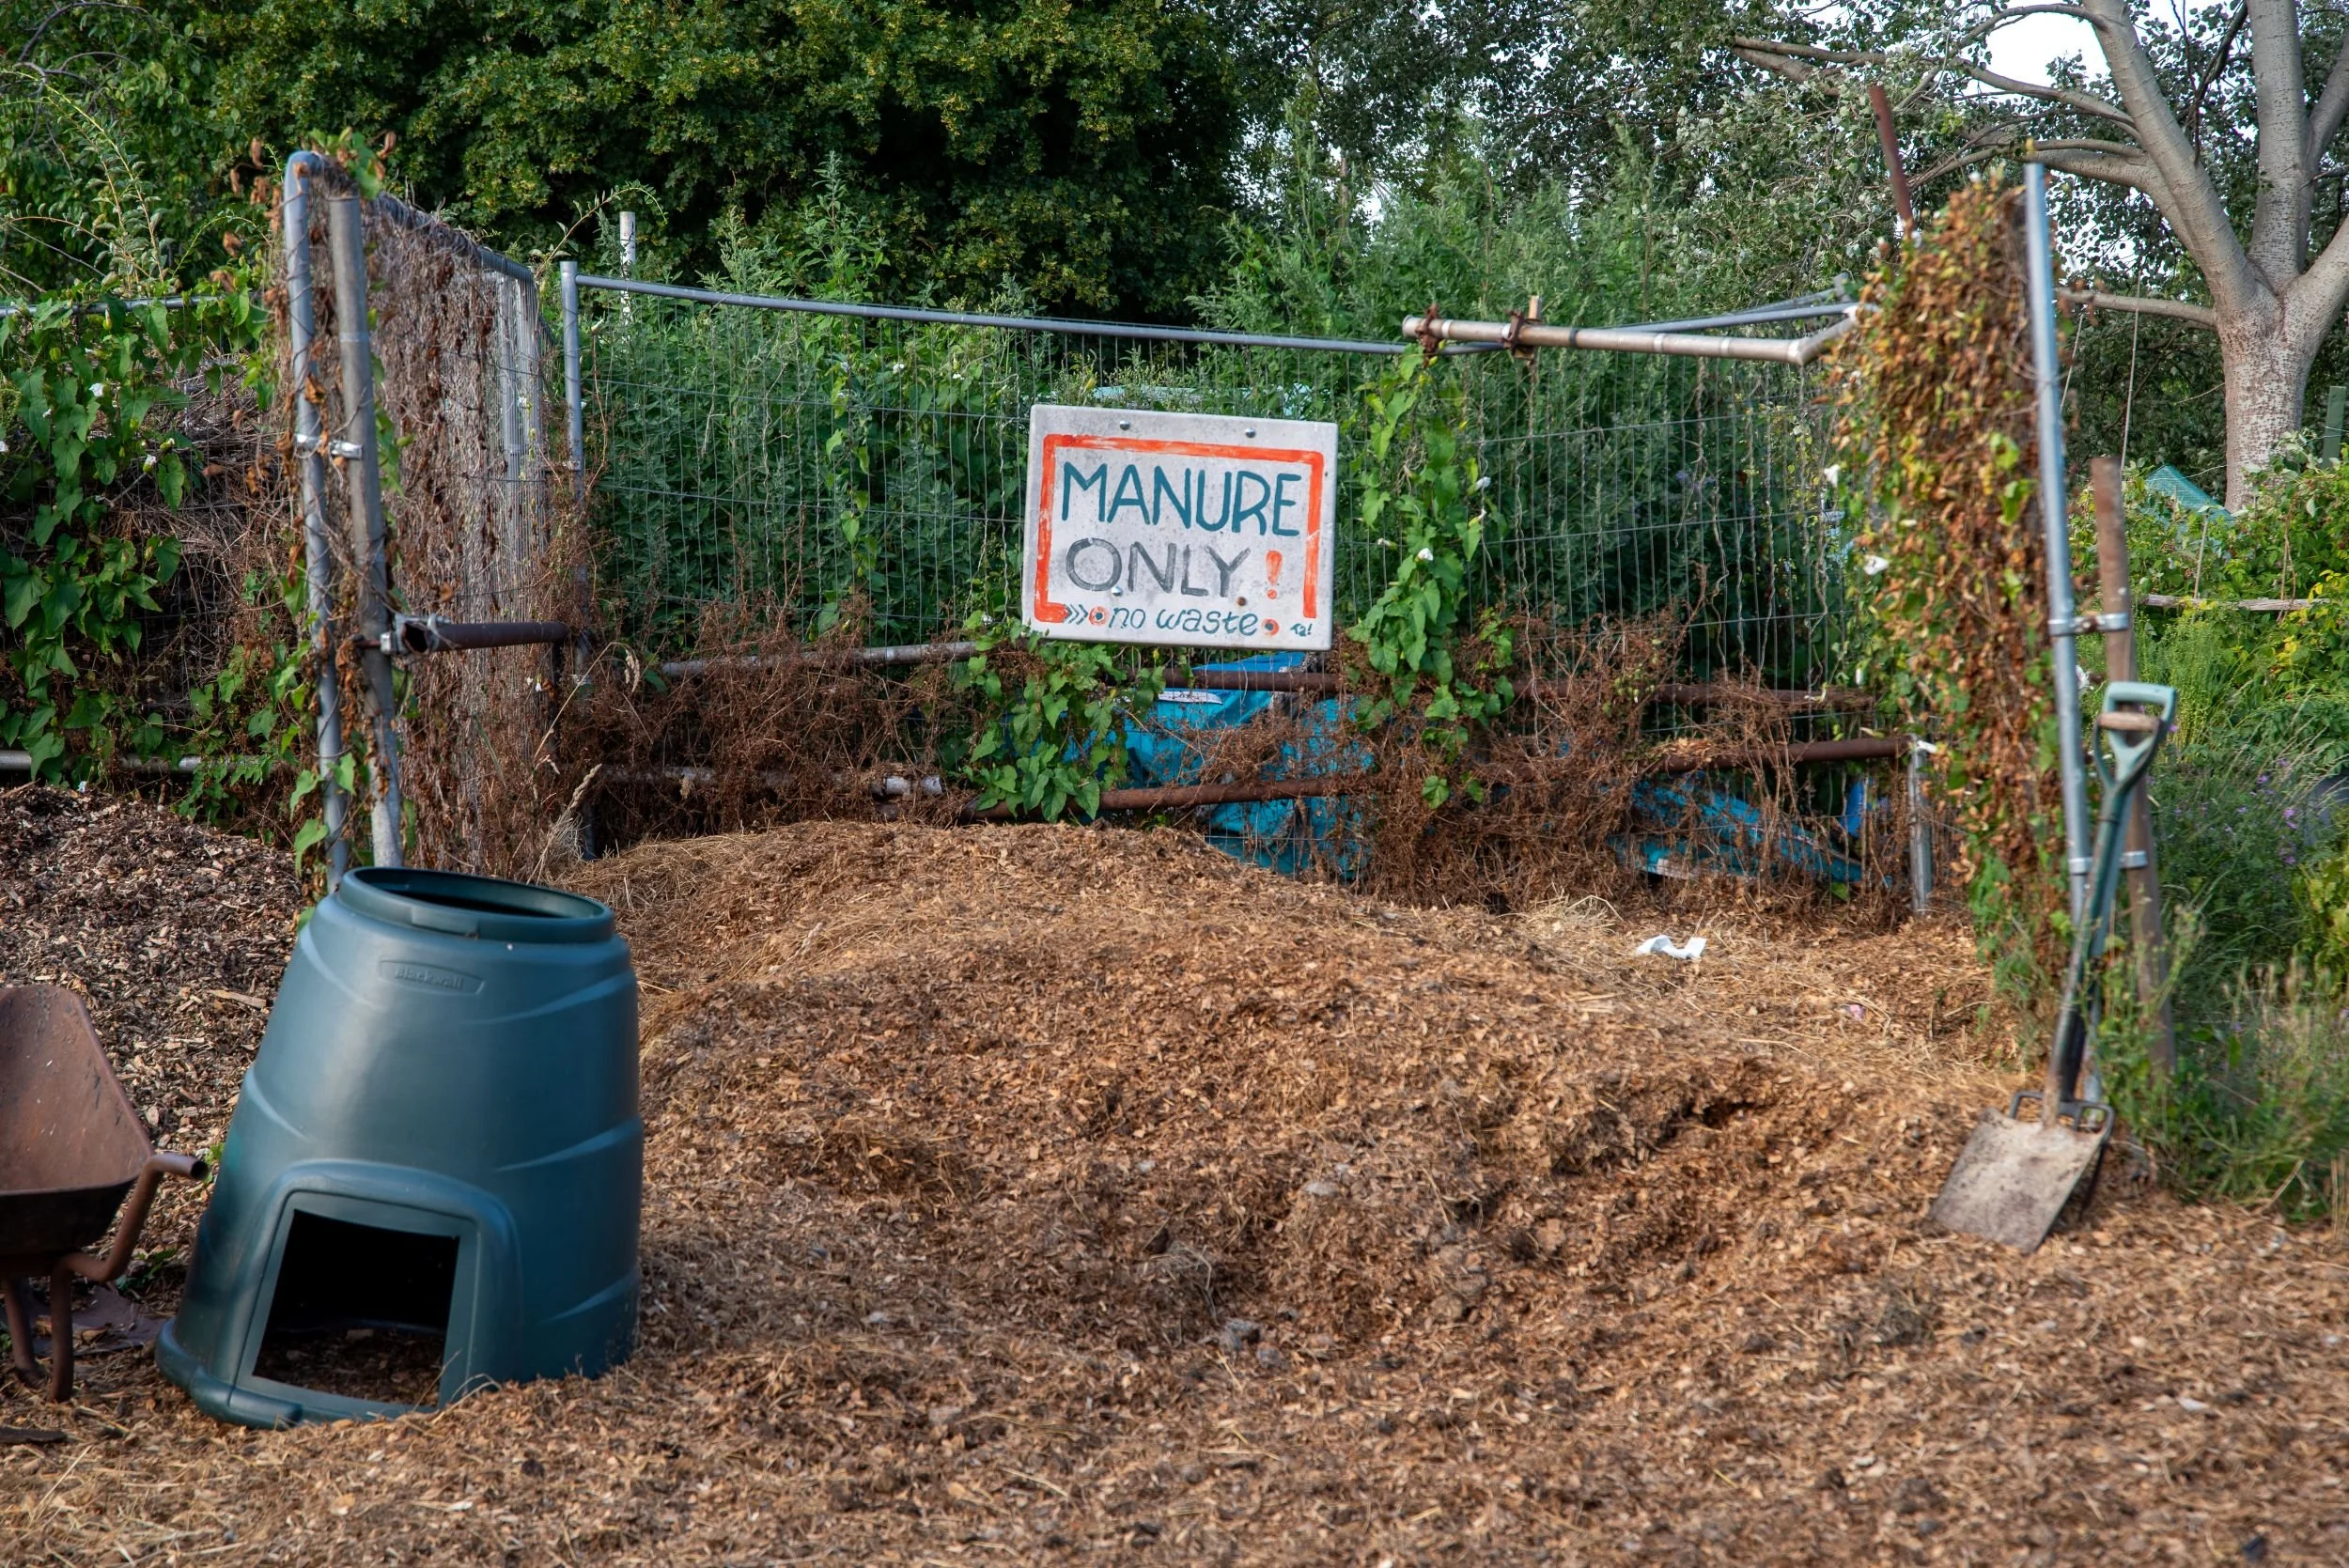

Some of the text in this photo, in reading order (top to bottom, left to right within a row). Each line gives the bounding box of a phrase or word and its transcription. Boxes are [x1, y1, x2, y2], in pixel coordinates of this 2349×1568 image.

[1062, 461, 1302, 536] MANURE
[1108, 606, 1259, 636] no waste
